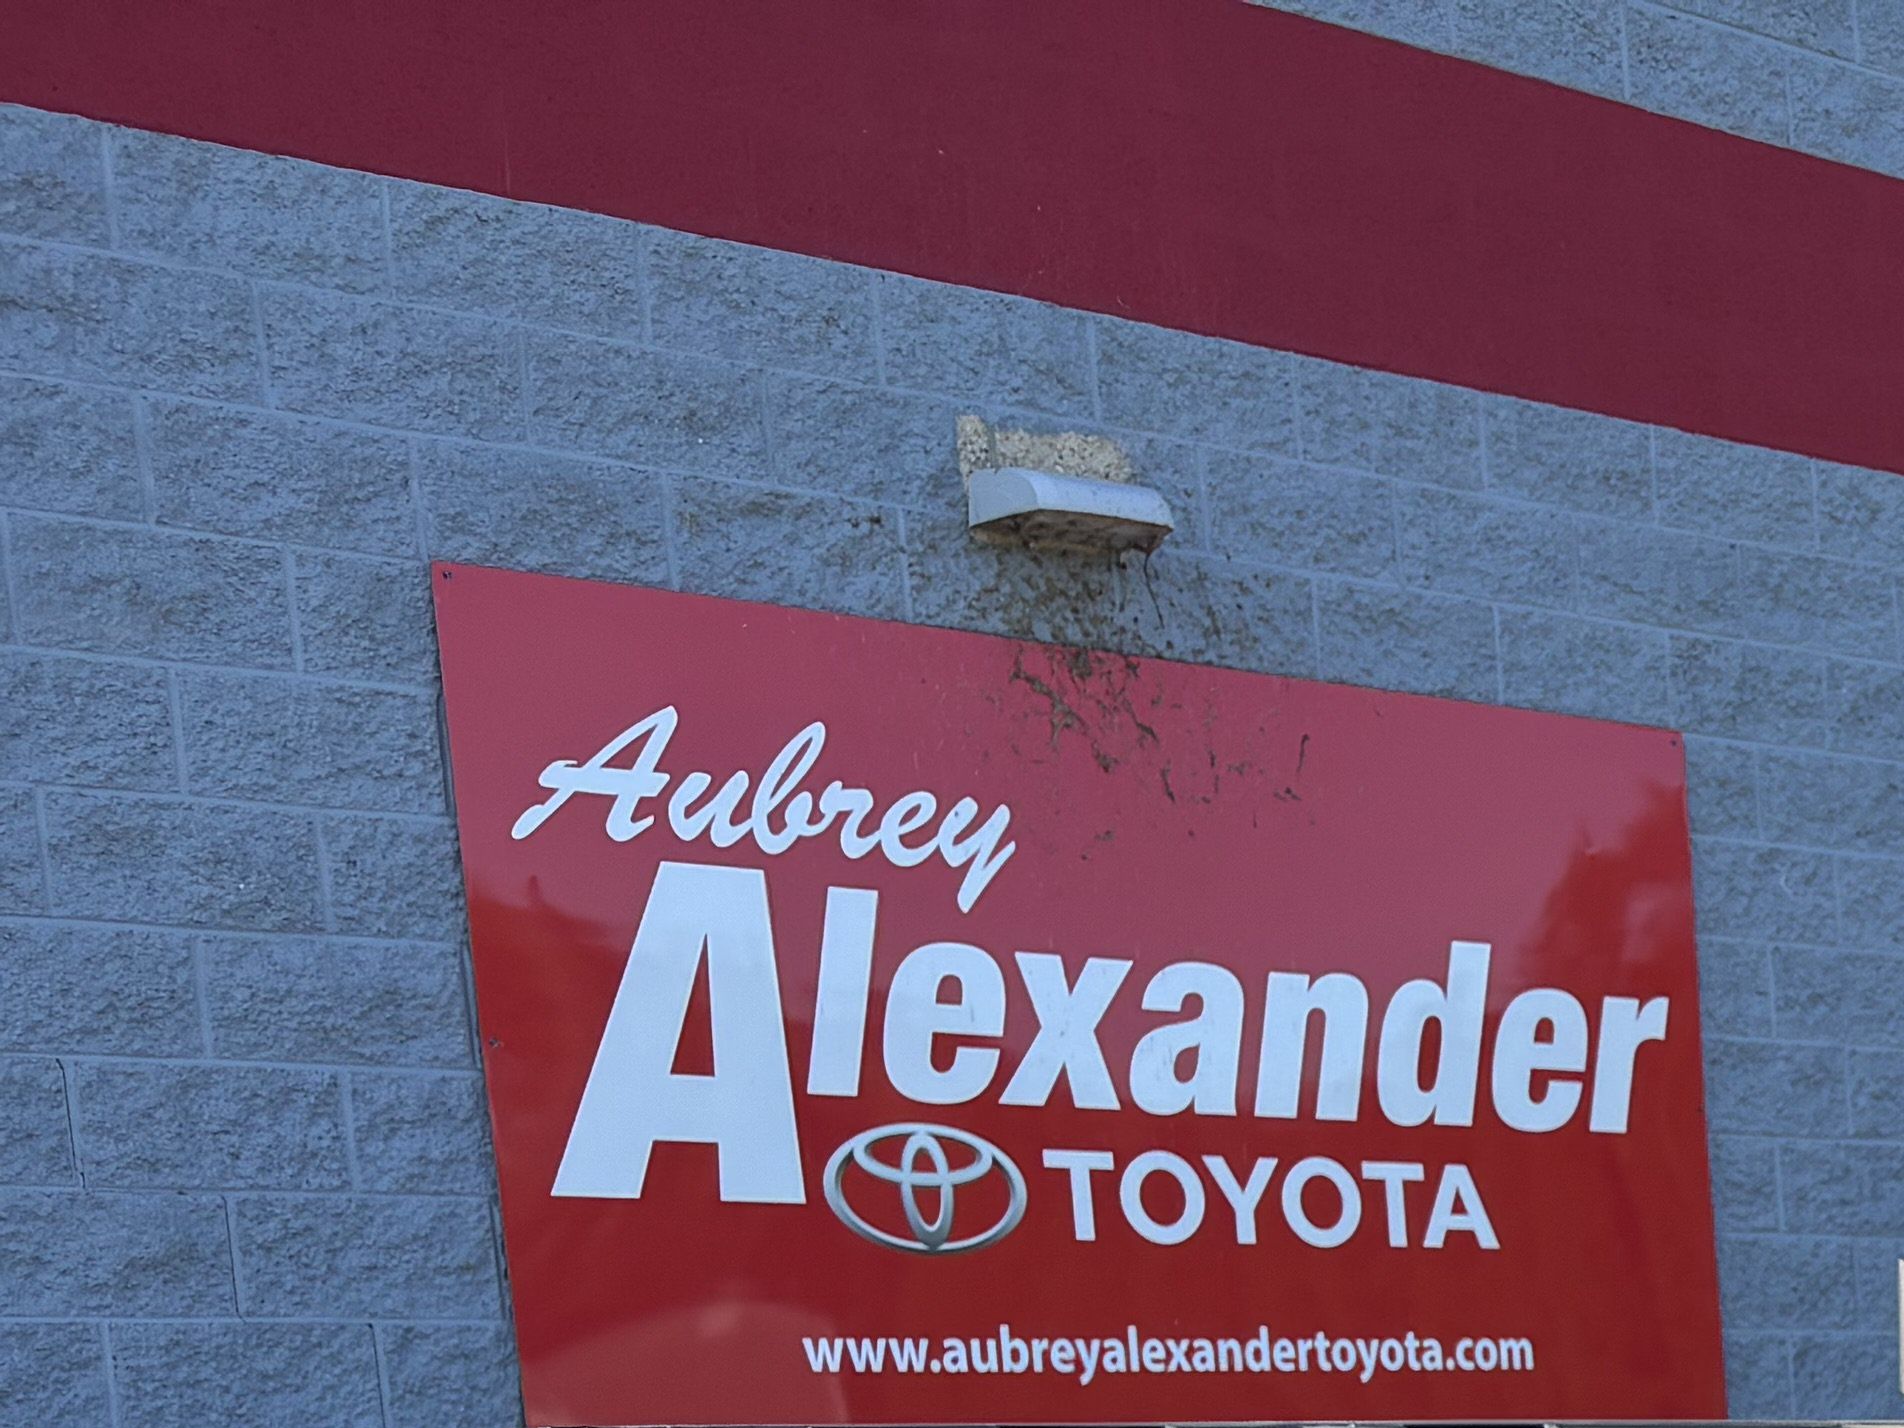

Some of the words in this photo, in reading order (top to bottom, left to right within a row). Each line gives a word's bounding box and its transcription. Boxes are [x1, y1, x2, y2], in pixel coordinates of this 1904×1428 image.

[511, 705, 1017, 913] Aubrey
[550, 861, 1668, 1206] Alexander
[1043, 1149, 1500, 1250] TOYOTA
[802, 1324, 1535, 1386] www.aubreyalexandertoyota.com
